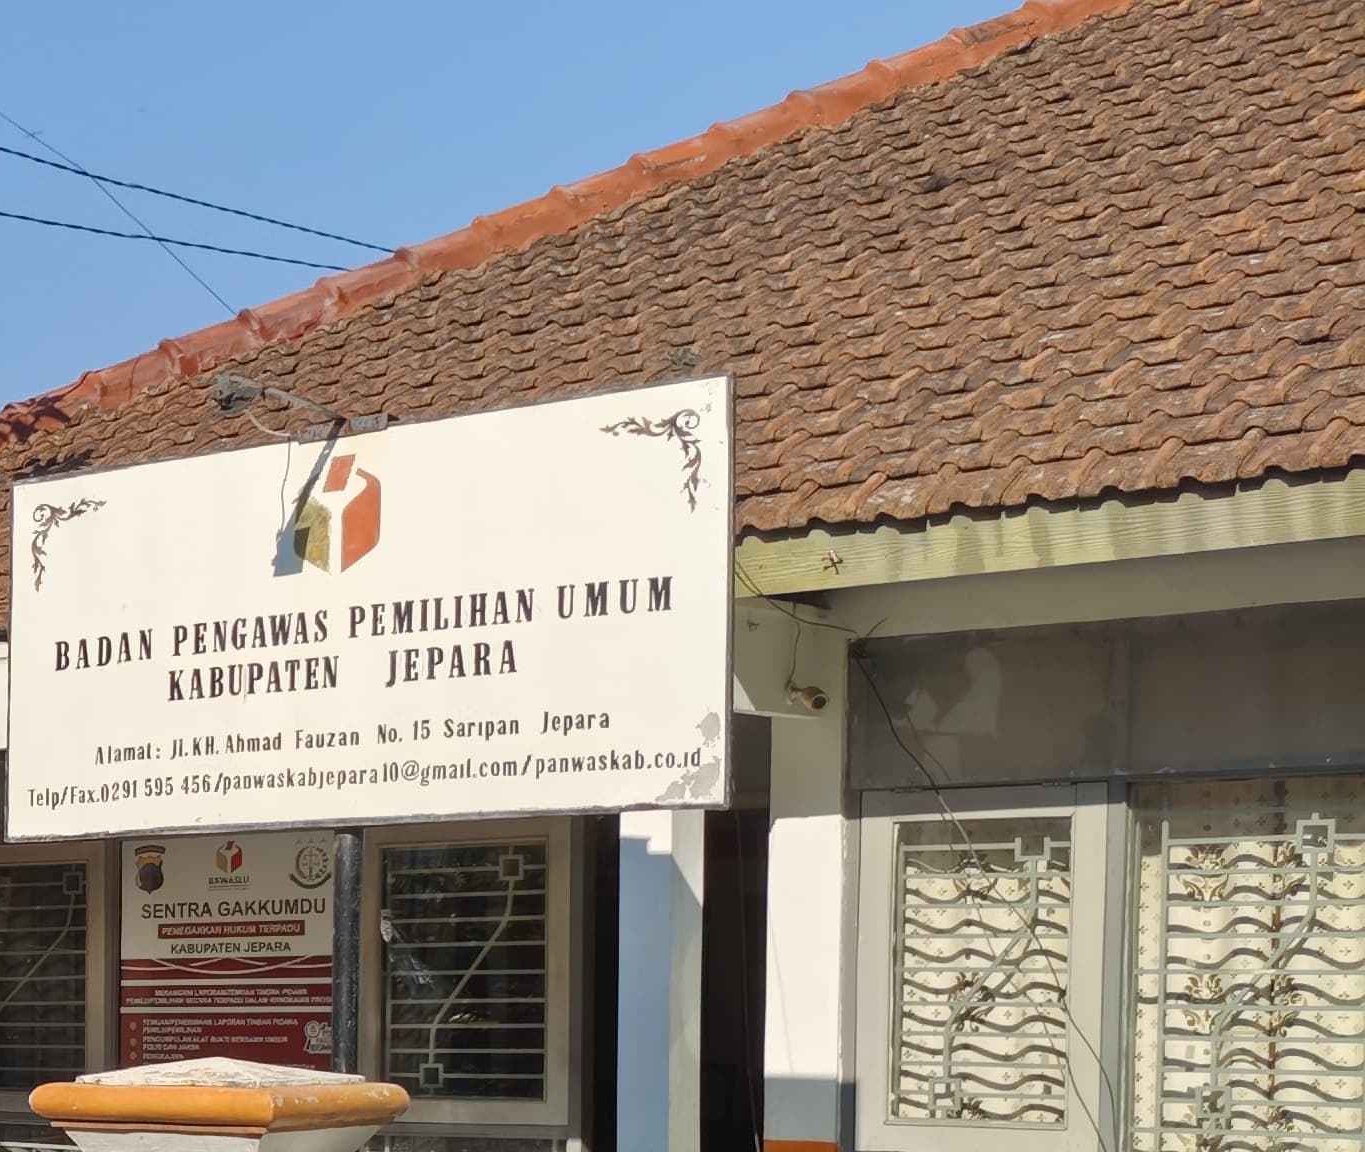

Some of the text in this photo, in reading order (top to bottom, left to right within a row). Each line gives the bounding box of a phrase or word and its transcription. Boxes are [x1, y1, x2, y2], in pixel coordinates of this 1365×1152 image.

[54, 575, 674, 671] BADAN PENGAWAS PEMILIHAN UMUM
[167, 639, 518, 702] KABUPATEN JEPARA
[94, 741, 161, 766] Alamat:
[225, 732, 283, 754] Ahmad
[294, 729, 361, 750] Fauzan
[376, 723, 403, 744] No.
[412, 719, 431, 741] 15
[443, 718, 520, 742] Saripan
[541, 711, 611, 738] Jepara
[144, 776, 174, 798] 595
[141, 898, 326, 919] SENTRA GAKKUMDU
[171, 942, 291, 954] KABUPATEN JEPARA
